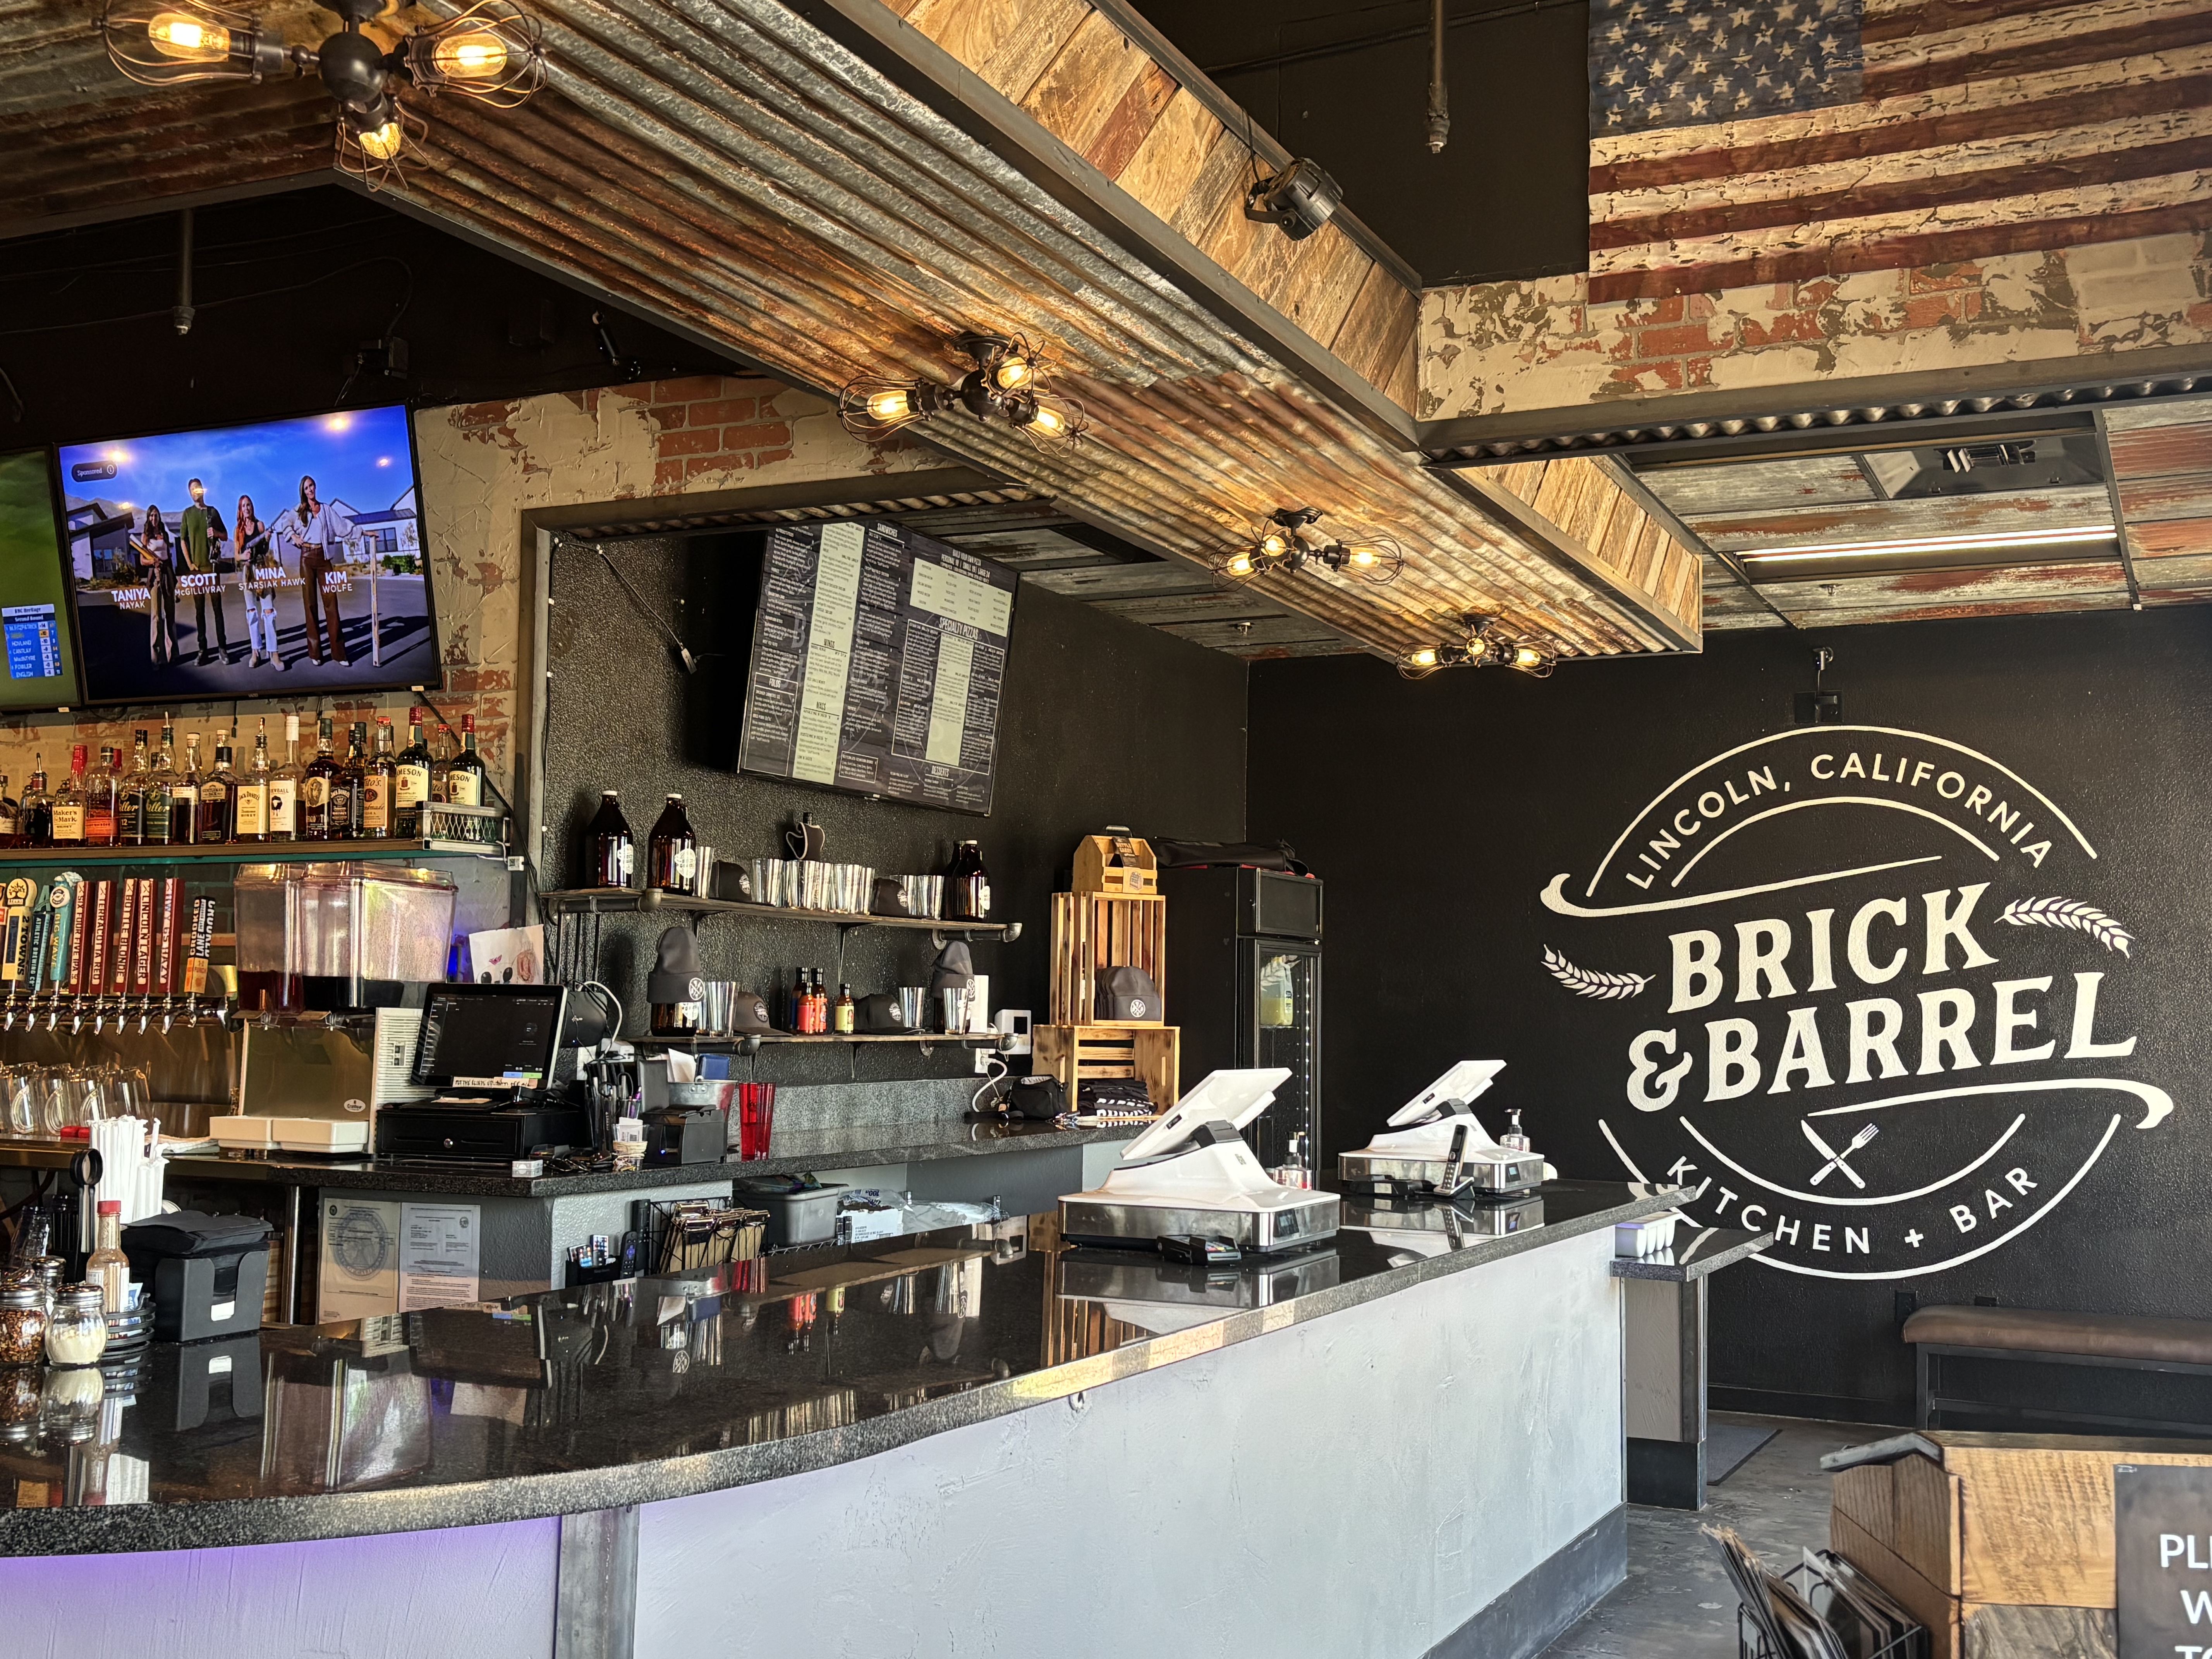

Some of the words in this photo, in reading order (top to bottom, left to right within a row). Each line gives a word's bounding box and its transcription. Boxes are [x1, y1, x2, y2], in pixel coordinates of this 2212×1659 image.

[77, 467, 102, 477] Sponsored
[180, 573, 217, 588] SCOTT
[255, 567, 286, 580] MINA
[325, 571, 347, 584] KIM
[111, 587, 151, 602] TANIYA
[175, 585, 225, 596] McGILLIVRAY
[239, 580, 278, 591] STARSIAK
[281, 578, 306, 587] HAWK
[322, 583, 353, 593] WOLFE
[120, 601, 145, 610] NAYAK
[939, 617, 962, 634] SPECIALTY
[963, 625, 979, 640] PIZZAS
[931, 765, 949, 777] DESSERTS
[1626, 765, 1791, 890] LINCOLN,
[1810, 752, 2052, 869] CALIFORNIA
[140, 895, 149, 939] LINCOLN
[33, 917, 42, 945] ATHLETIC
[189, 899, 201, 956] CROOKED
[17, 926, 28, 975] TOWNS
[51, 935, 60, 968] WAVE
[196, 932, 206, 957] LANE
[1667, 882, 1999, 1014] BRICK
[71, 958, 80, 974] IPA
[137, 943, 149, 979] LAGER
[93, 963, 101, 981] RED
[1666, 1156, 1870, 1254] KITCHEN
[1949, 1166, 2038, 1233] BAR
[2160, 1534, 2212, 1569] PL
